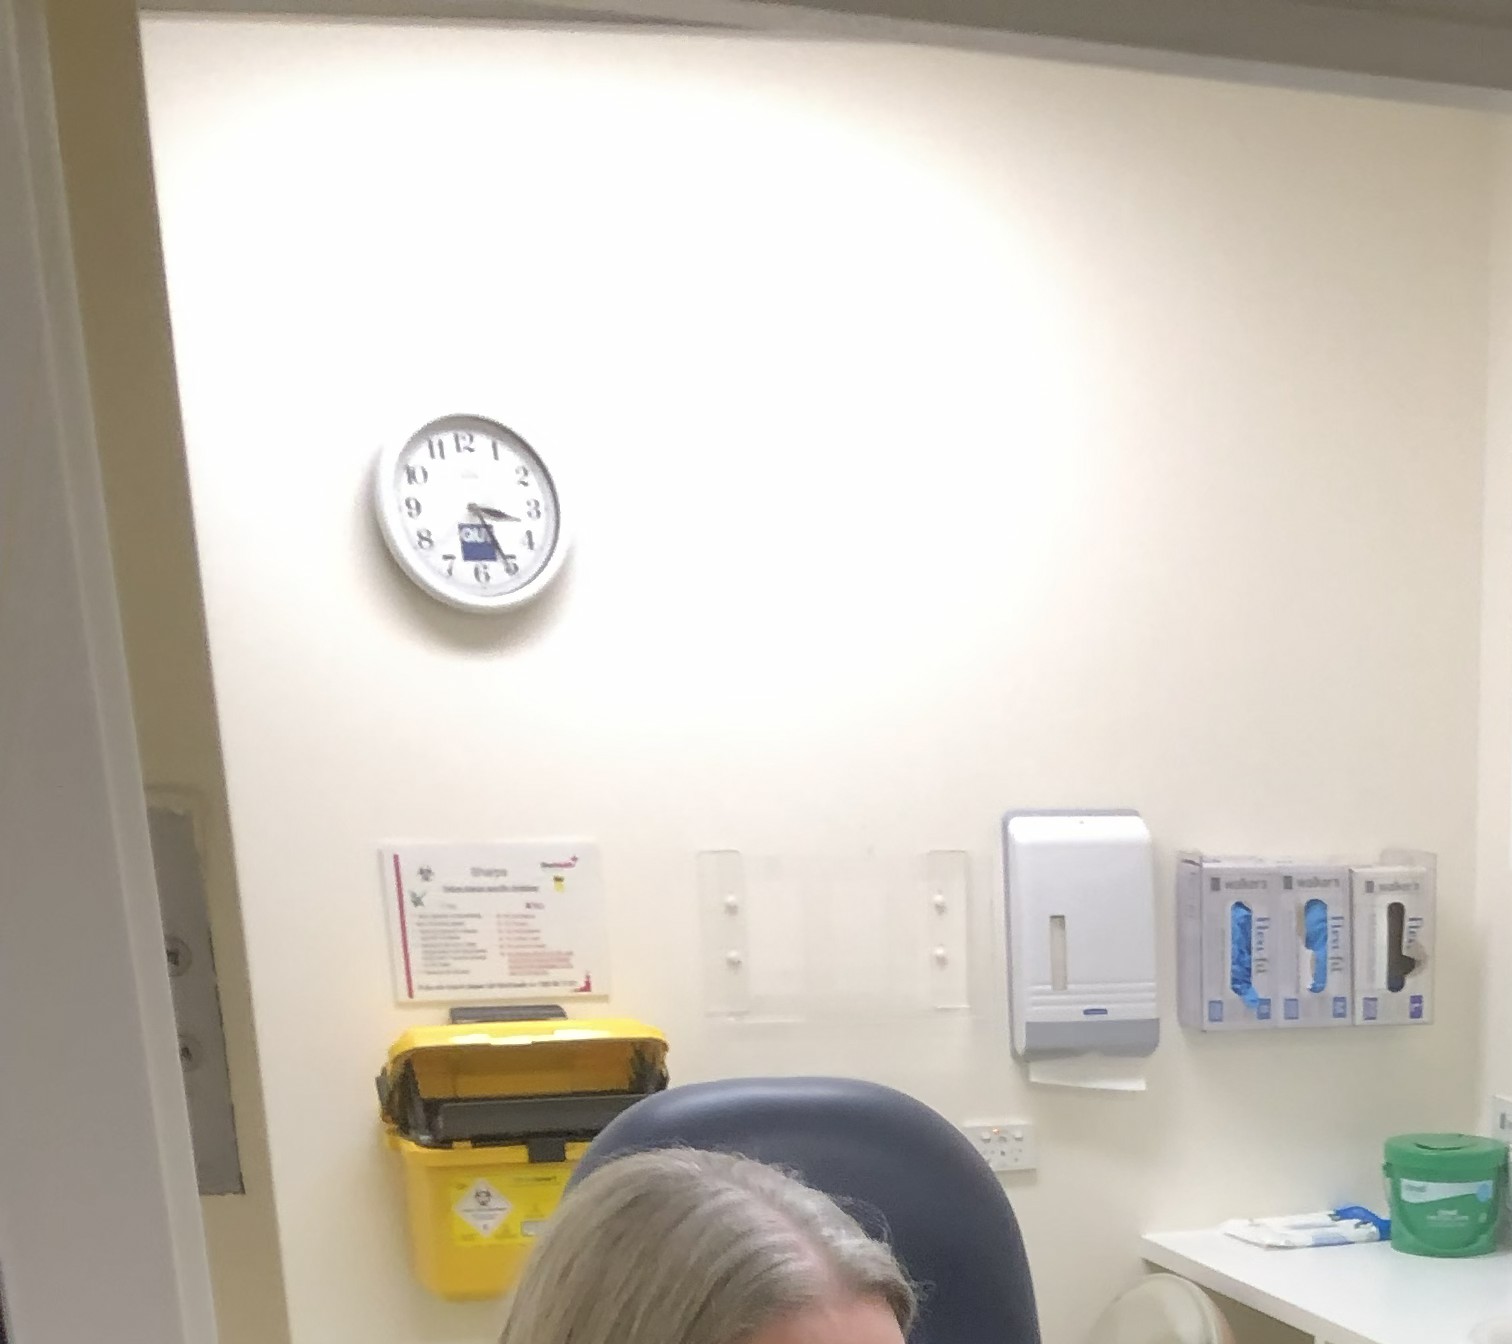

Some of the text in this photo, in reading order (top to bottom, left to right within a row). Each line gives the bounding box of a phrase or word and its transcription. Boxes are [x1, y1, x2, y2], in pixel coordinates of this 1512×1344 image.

[428, 439, 446, 460] 11
[454, 433, 475, 453] 12
[491, 440, 499, 461] 1
[406, 465, 428, 485] 10
[515, 466, 529, 487] 2
[405, 497, 422, 519] 9
[526, 499, 541, 519] 3
[416, 528, 434, 549] 8
[521, 530, 535, 550] 4
[442, 554, 456, 576] 7
[474, 563, 490, 584] 6
[504, 554, 519, 576] 5
